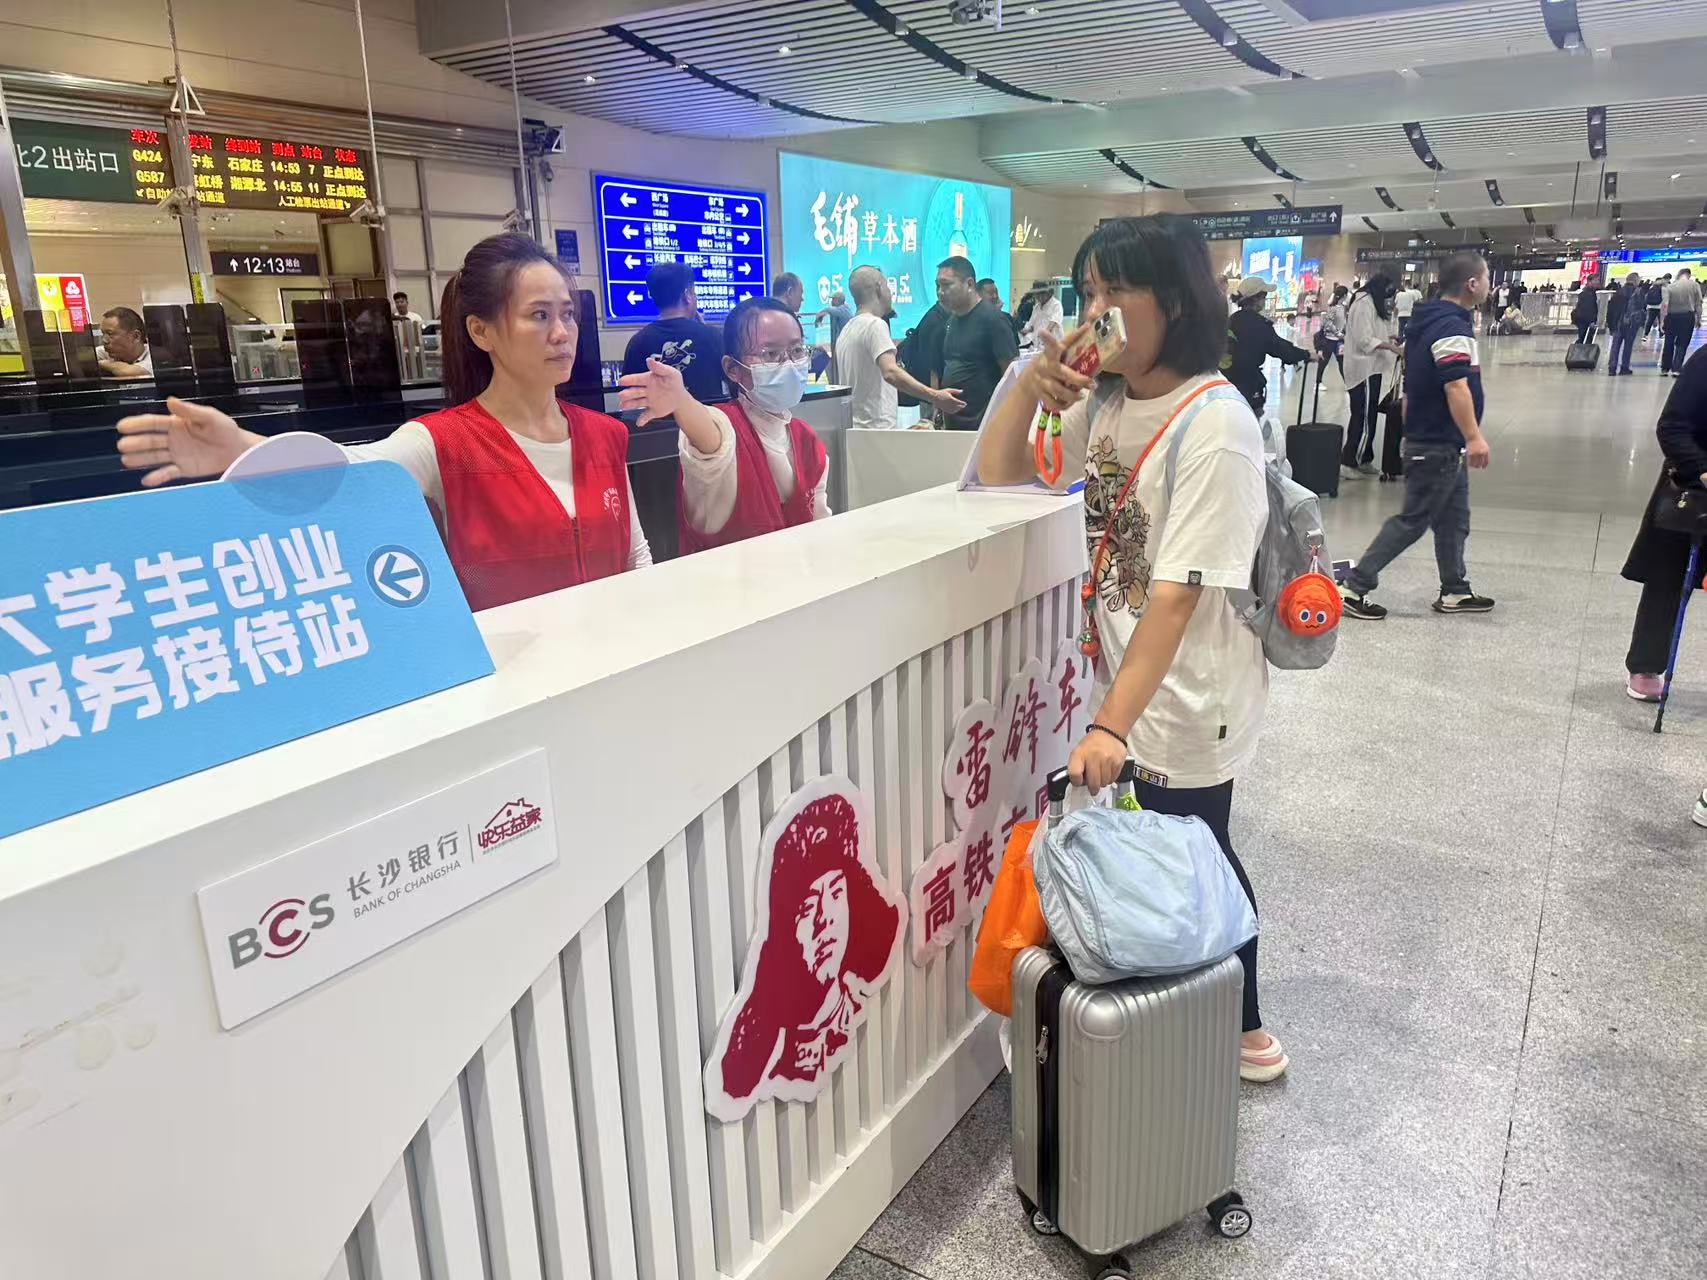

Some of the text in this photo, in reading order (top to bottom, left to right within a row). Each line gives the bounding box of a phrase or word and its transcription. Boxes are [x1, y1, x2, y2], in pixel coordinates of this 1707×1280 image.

[130, 128, 357, 163] 车次 发站 终到站 到点 站台 状态
[132, 149, 163, 163] G424
[227, 157, 264, 173] 石家庄
[271, 160, 301, 175] 14:53
[308, 164, 316, 175] 7
[323, 165, 365, 181] 正点到达
[193, 174, 223, 190] 虹桥
[230, 176, 267, 192] 湘潭北
[273, 180, 303, 193] 14:55
[308, 182, 319, 194] 11
[325, 183, 368, 199] 正点到达
[860, 210, 918, 253] 草本酒
[0, 594, 369, 760] 服务接待站
[957, 657, 1081, 809] 雷锋车
[347, 831, 459, 901] 长沙银行
[353, 860, 462, 919] BANK OF CHANGSHA
[228, 893, 335, 970] BCS
